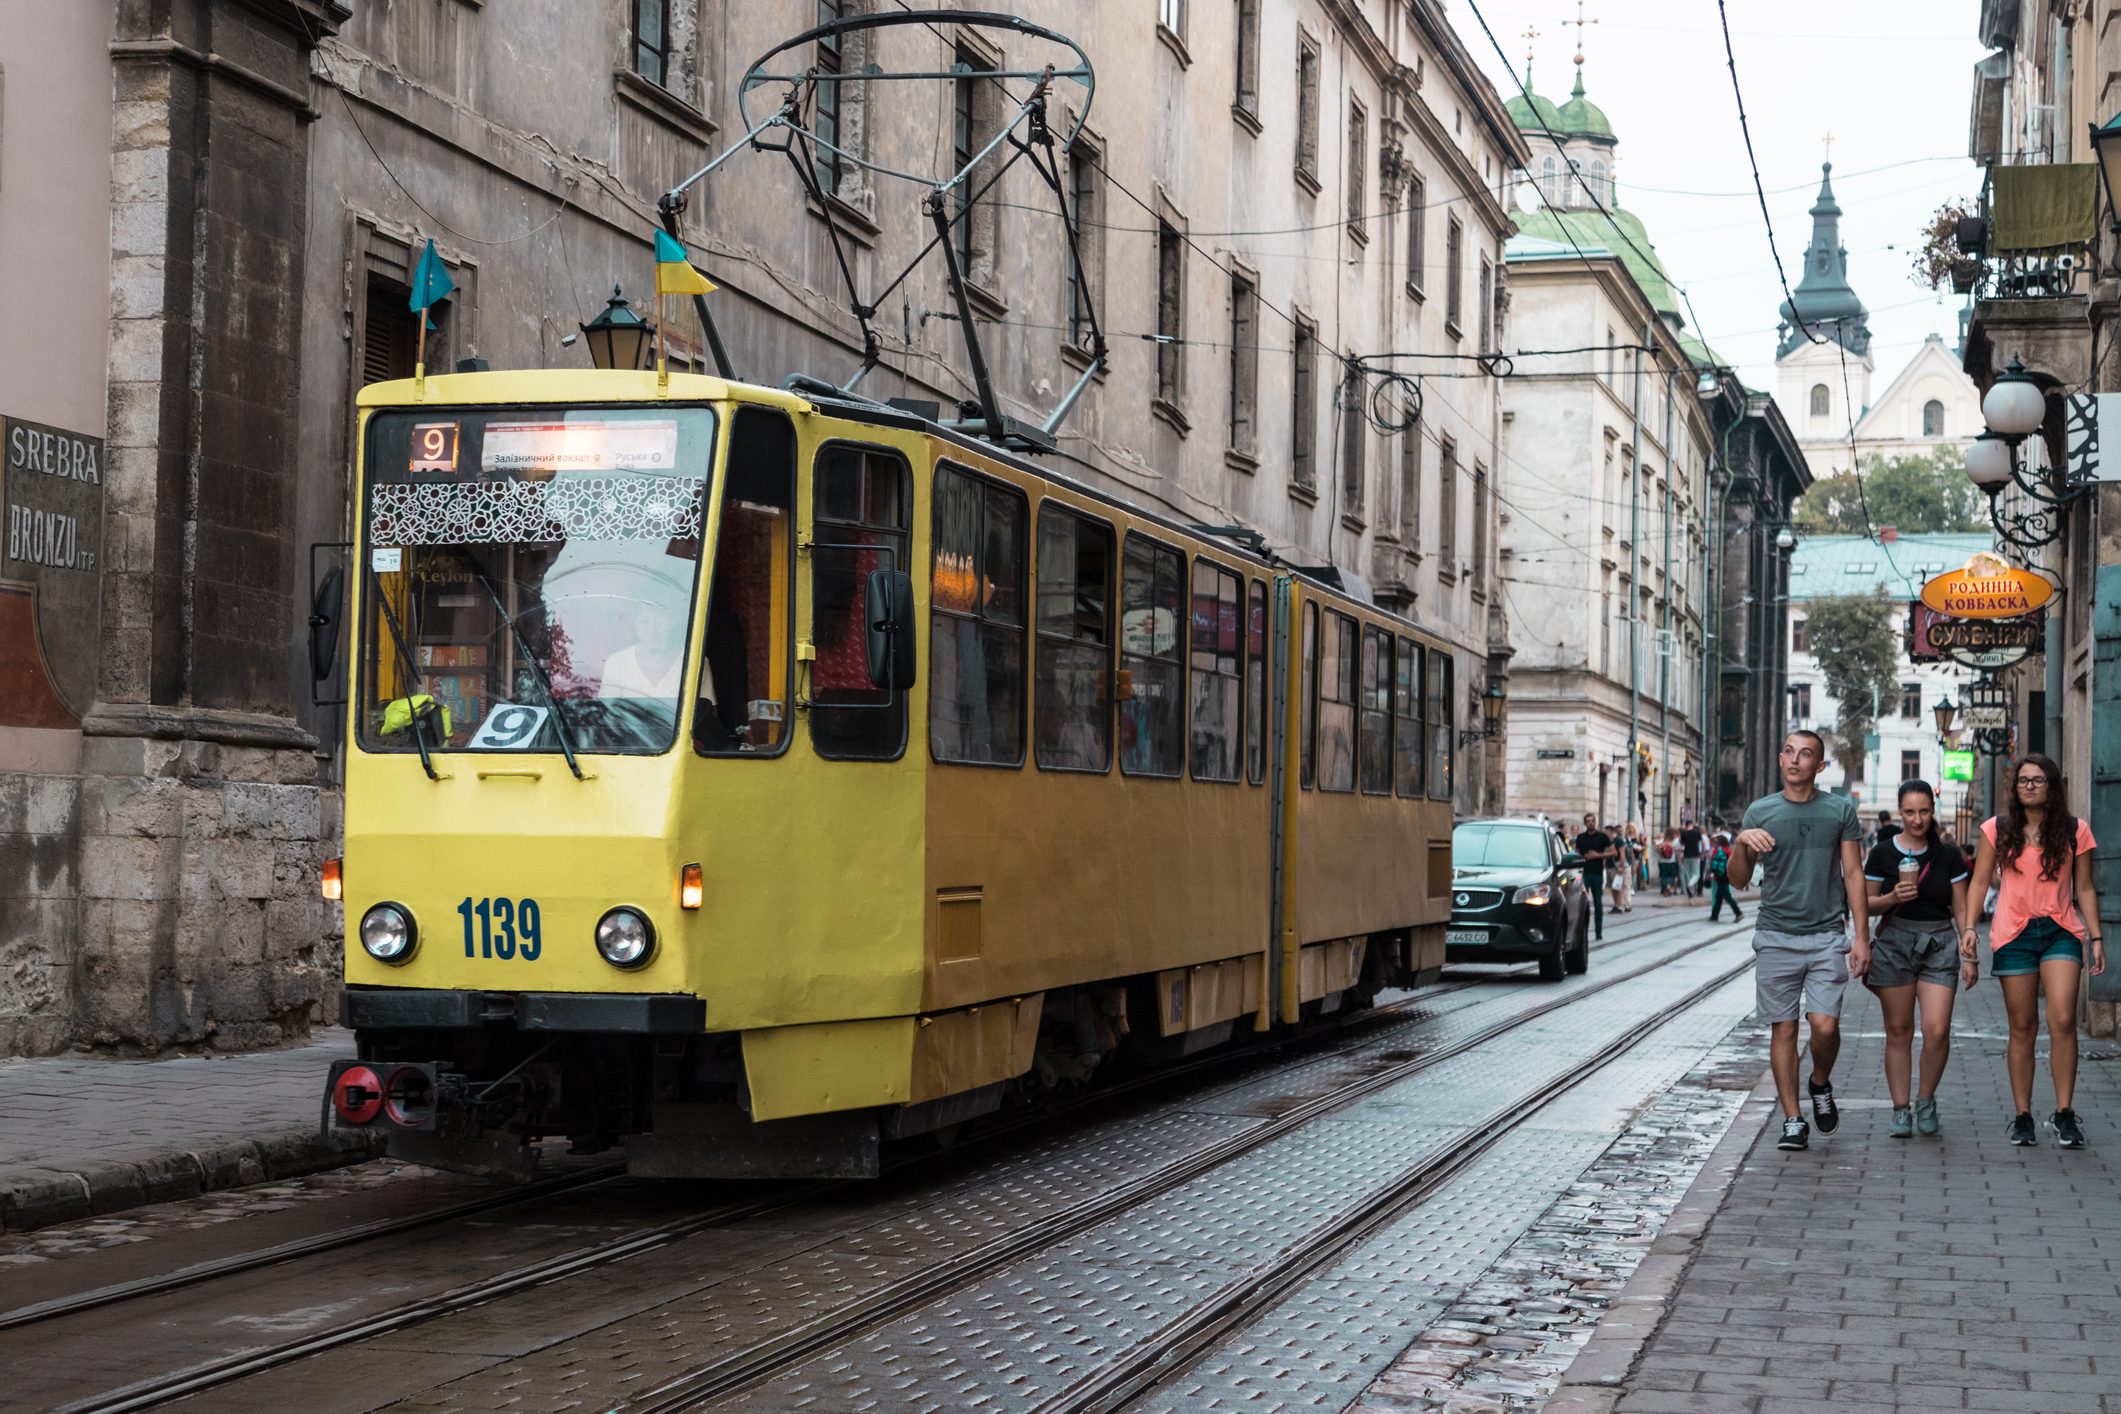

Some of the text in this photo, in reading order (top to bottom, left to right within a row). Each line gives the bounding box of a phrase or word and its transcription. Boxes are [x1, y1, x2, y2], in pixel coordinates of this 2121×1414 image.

[11, 427, 99, 484] SREBRA
[424, 429, 444, 460] 9
[495, 453, 554, 463] Залізничний
[10, 504, 77, 567] BRONZU
[1944, 596, 2030, 611] КОВБАСКА
[1949, 580, 2025, 595] РОДИННА
[482, 707, 538, 746] 9
[458, 896, 541, 961] 1139
